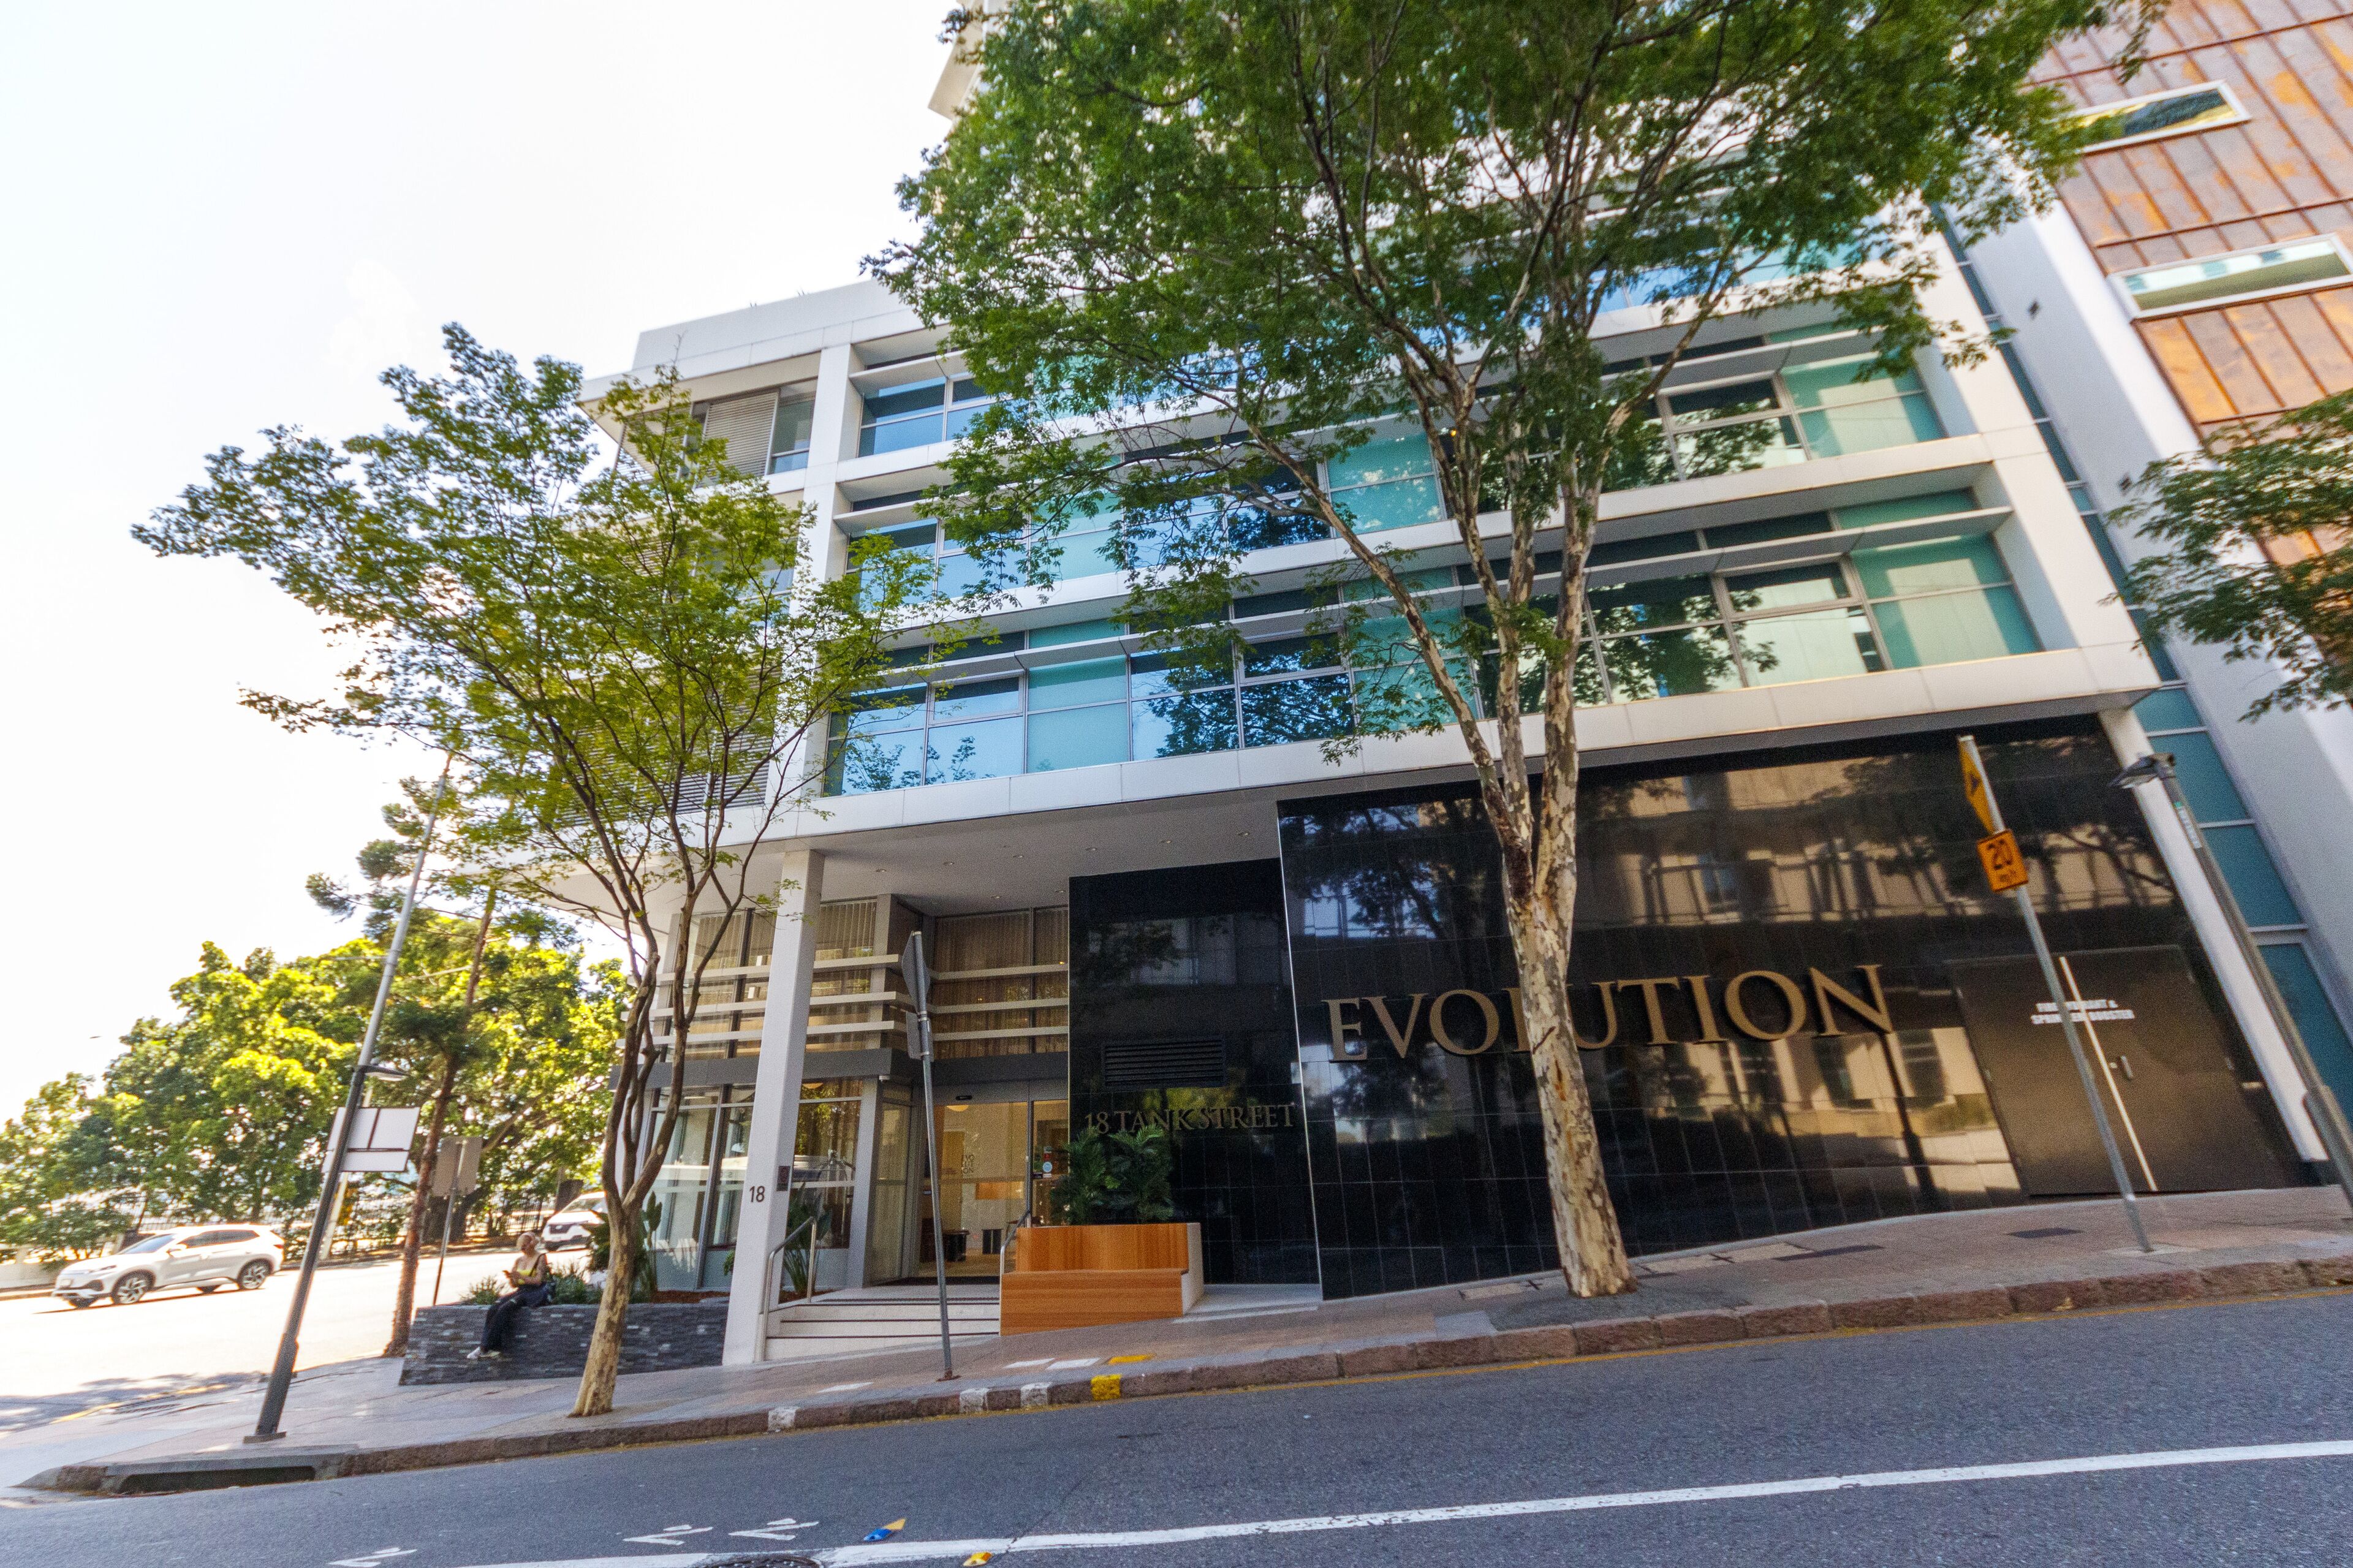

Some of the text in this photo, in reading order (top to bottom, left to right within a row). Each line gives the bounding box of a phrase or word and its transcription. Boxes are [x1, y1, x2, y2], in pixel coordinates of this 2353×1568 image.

[1986, 838, 2013, 870] 20
[1084, 1102, 1296, 1134] 18 TANK STREET
[749, 1185, 765, 1203] 18
